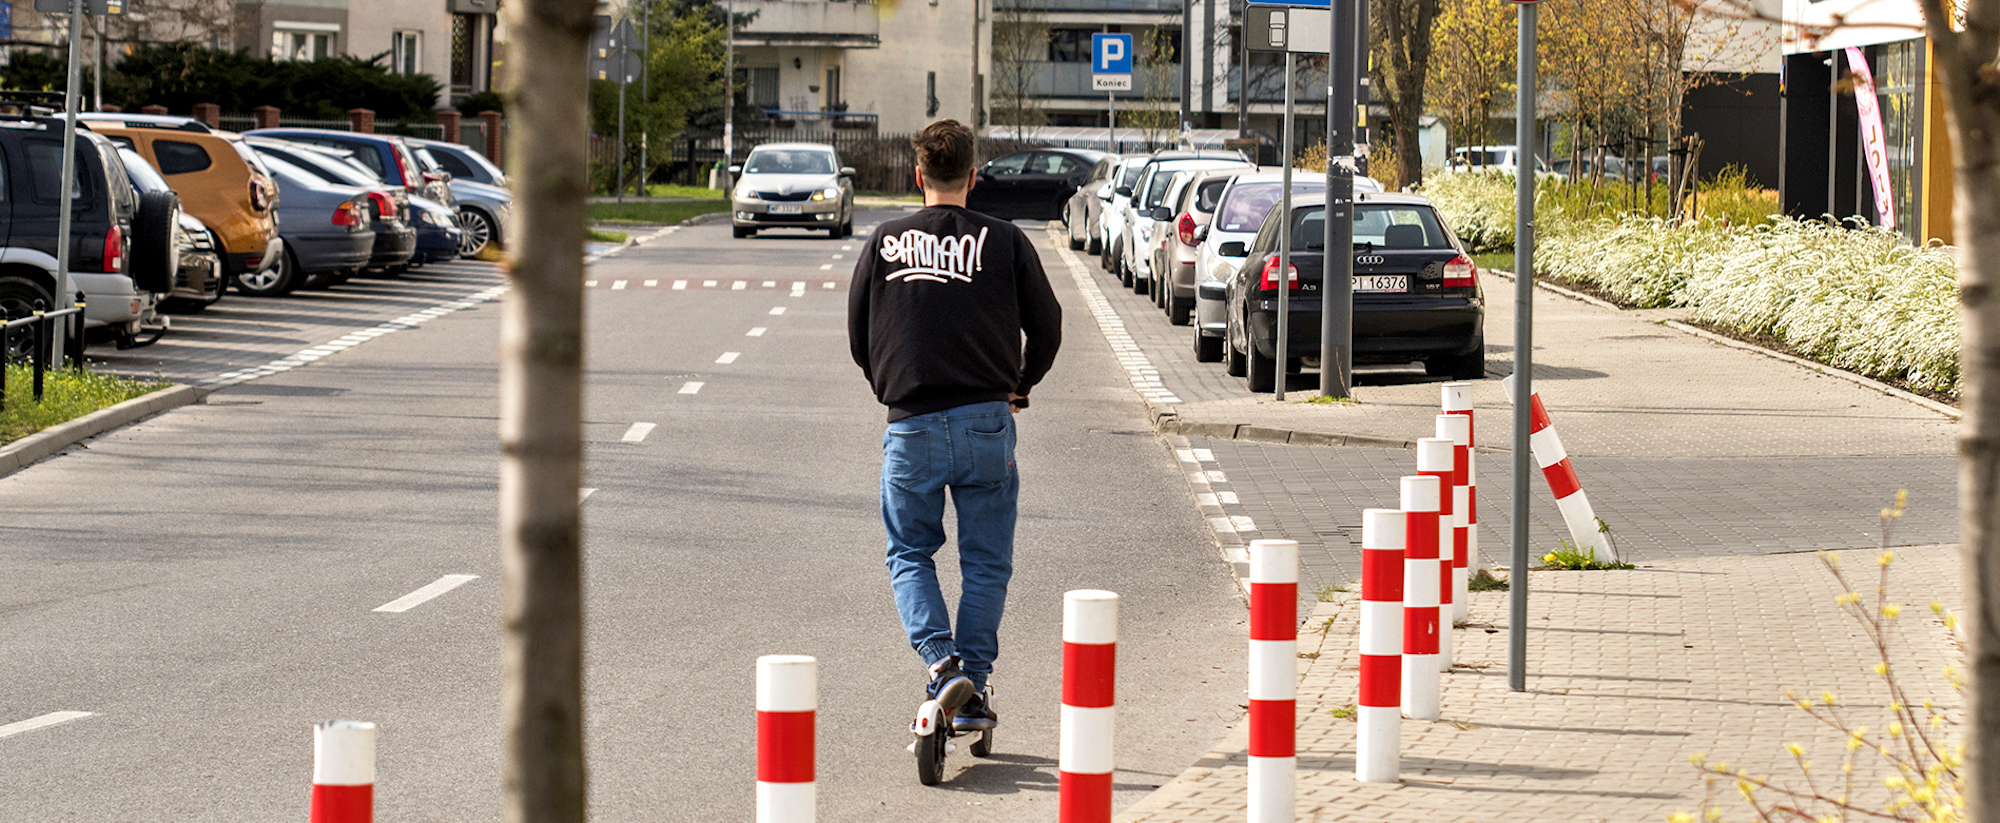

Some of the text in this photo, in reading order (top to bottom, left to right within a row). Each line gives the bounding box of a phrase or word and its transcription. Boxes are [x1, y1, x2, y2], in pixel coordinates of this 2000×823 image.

[1102, 38, 1124, 69] P
[1096, 79, 1126, 87] Koniec
[1301, 283, 1317, 291] A3
[1370, 276, 1406, 289] 16376
